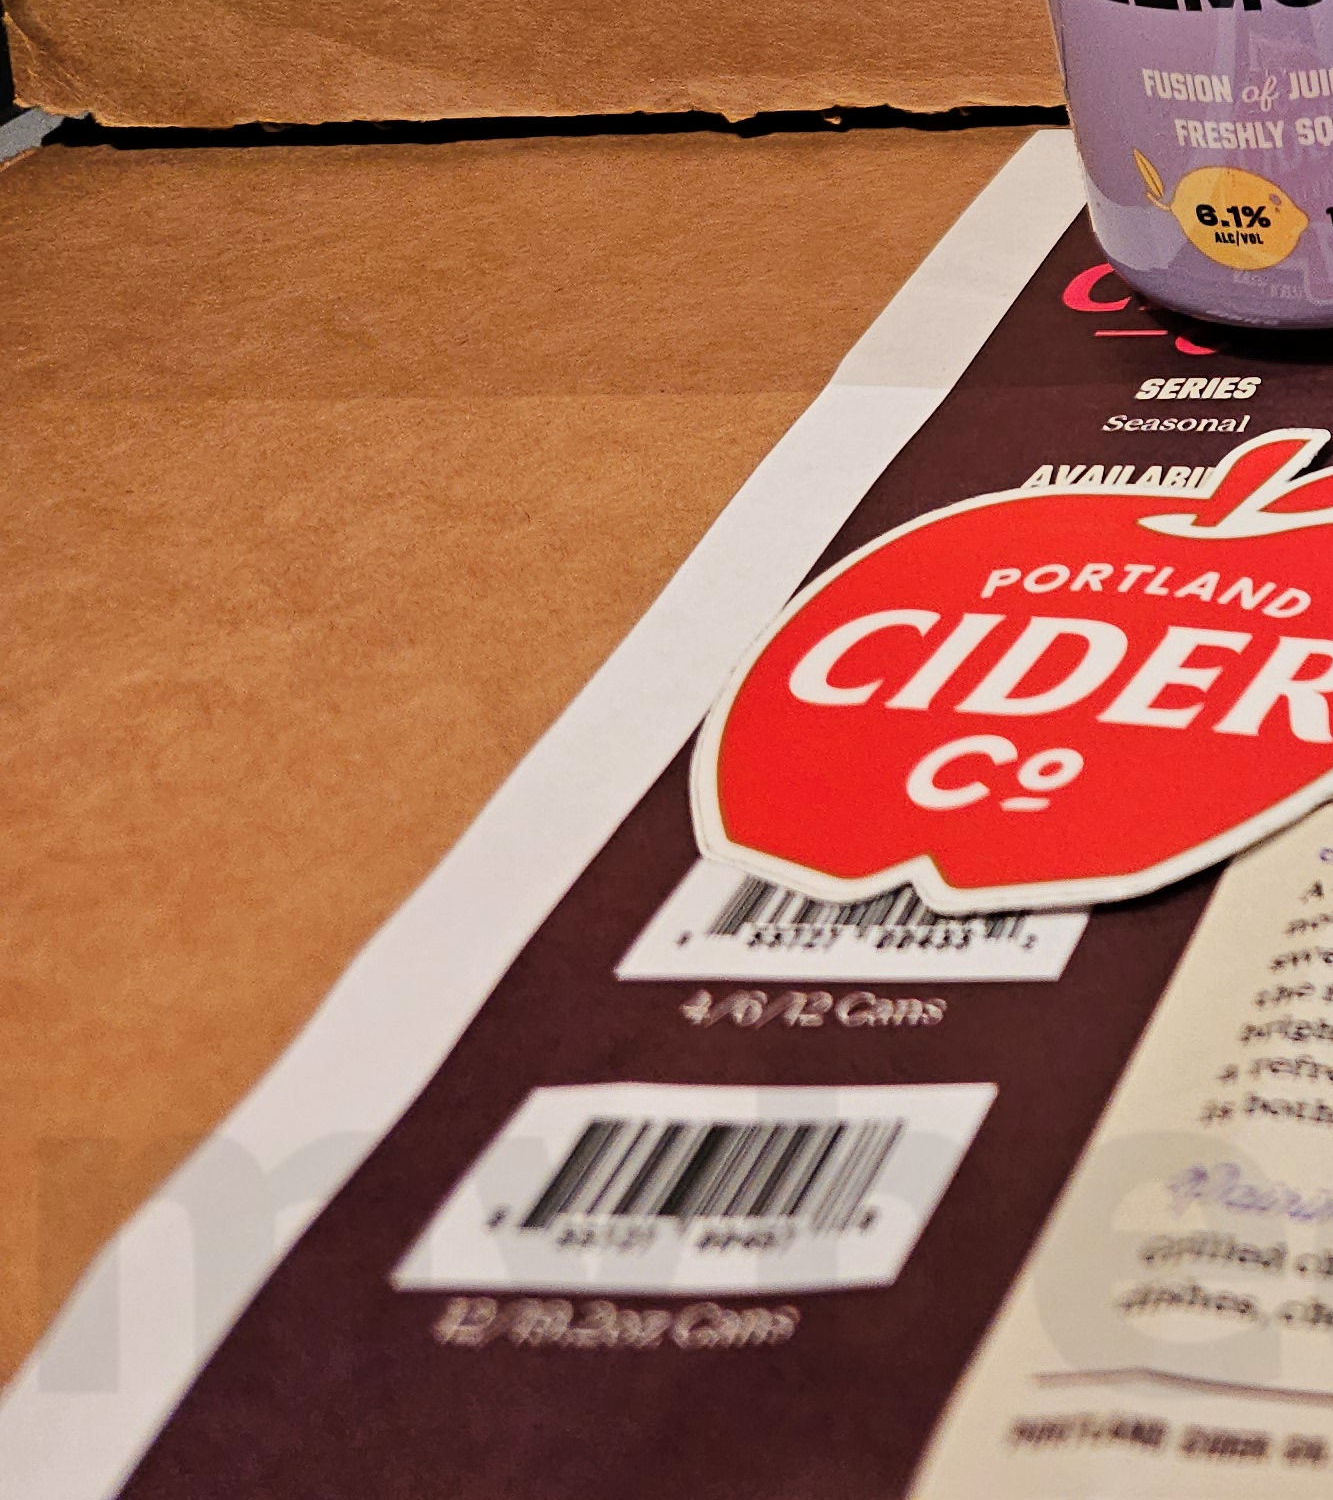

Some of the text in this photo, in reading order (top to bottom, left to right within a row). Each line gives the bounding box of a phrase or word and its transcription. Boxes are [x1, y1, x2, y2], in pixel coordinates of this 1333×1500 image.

[1142, 68, 1233, 103] FUSION
[1241, 68, 1281, 112] of
[1174, 118, 1285, 149] FRESHLY
[1195, 204, 1271, 228] 6.1%
[1215, 231, 1264, 246] ALC/VOL
[1134, 377, 1261, 400] SERIES
[1102, 414, 1250, 432] Seasonal
[1020, 464, 1216, 489] AVAILABI
[980, 562, 1313, 620] PORTLAND
[835, 991, 949, 1028] Cans
